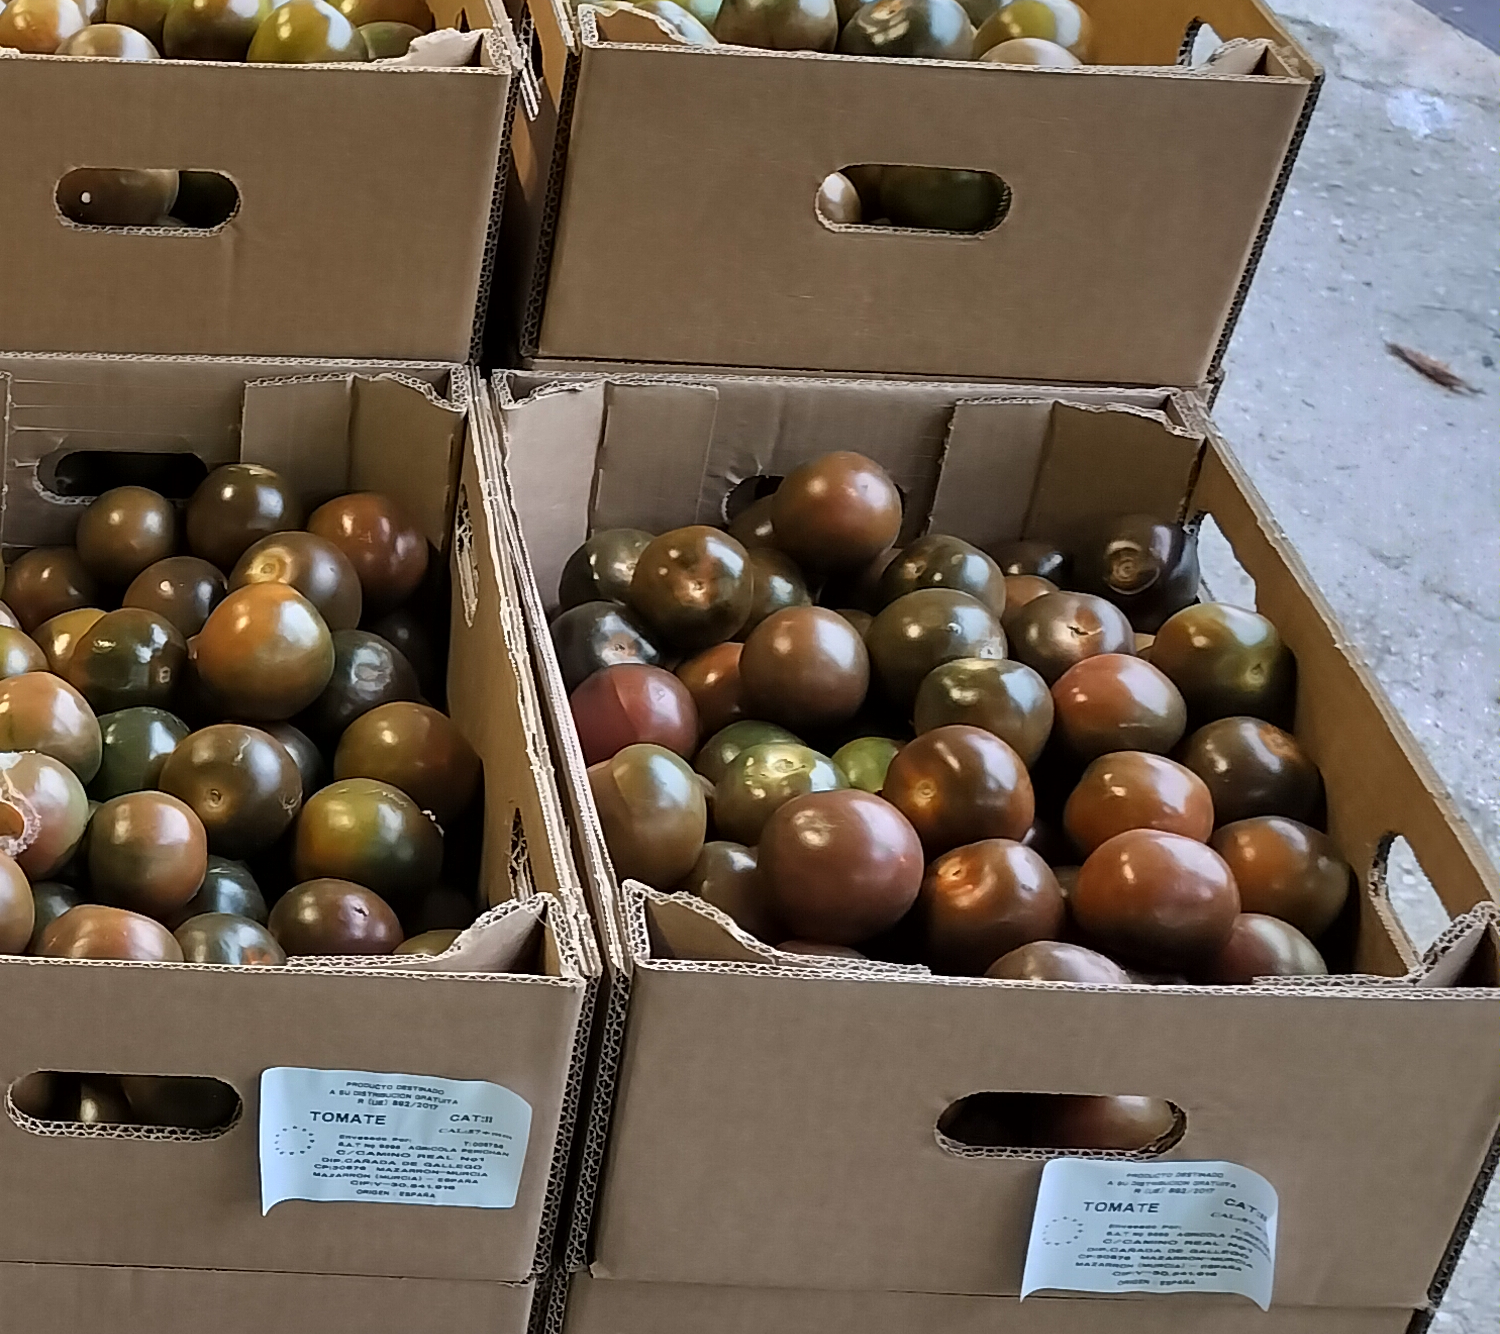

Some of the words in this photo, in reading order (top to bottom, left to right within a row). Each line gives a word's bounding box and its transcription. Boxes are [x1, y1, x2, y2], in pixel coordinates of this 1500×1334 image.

[346, 1082, 393, 1090] PRODUCTO
[396, 1084, 445, 1095] DESTINADO
[353, 1090, 412, 1099] DISTRIBUCION
[415, 1092, 458, 1105] GRATUITA
[310, 1111, 387, 1125] TOMATE
[449, 1114, 493, 1124] CAT:II
[336, 1149, 411, 1158] C/CAMINO
[423, 1162, 482, 1170] GALLEGO
[1083, 1201, 1160, 1213] TOMATE
